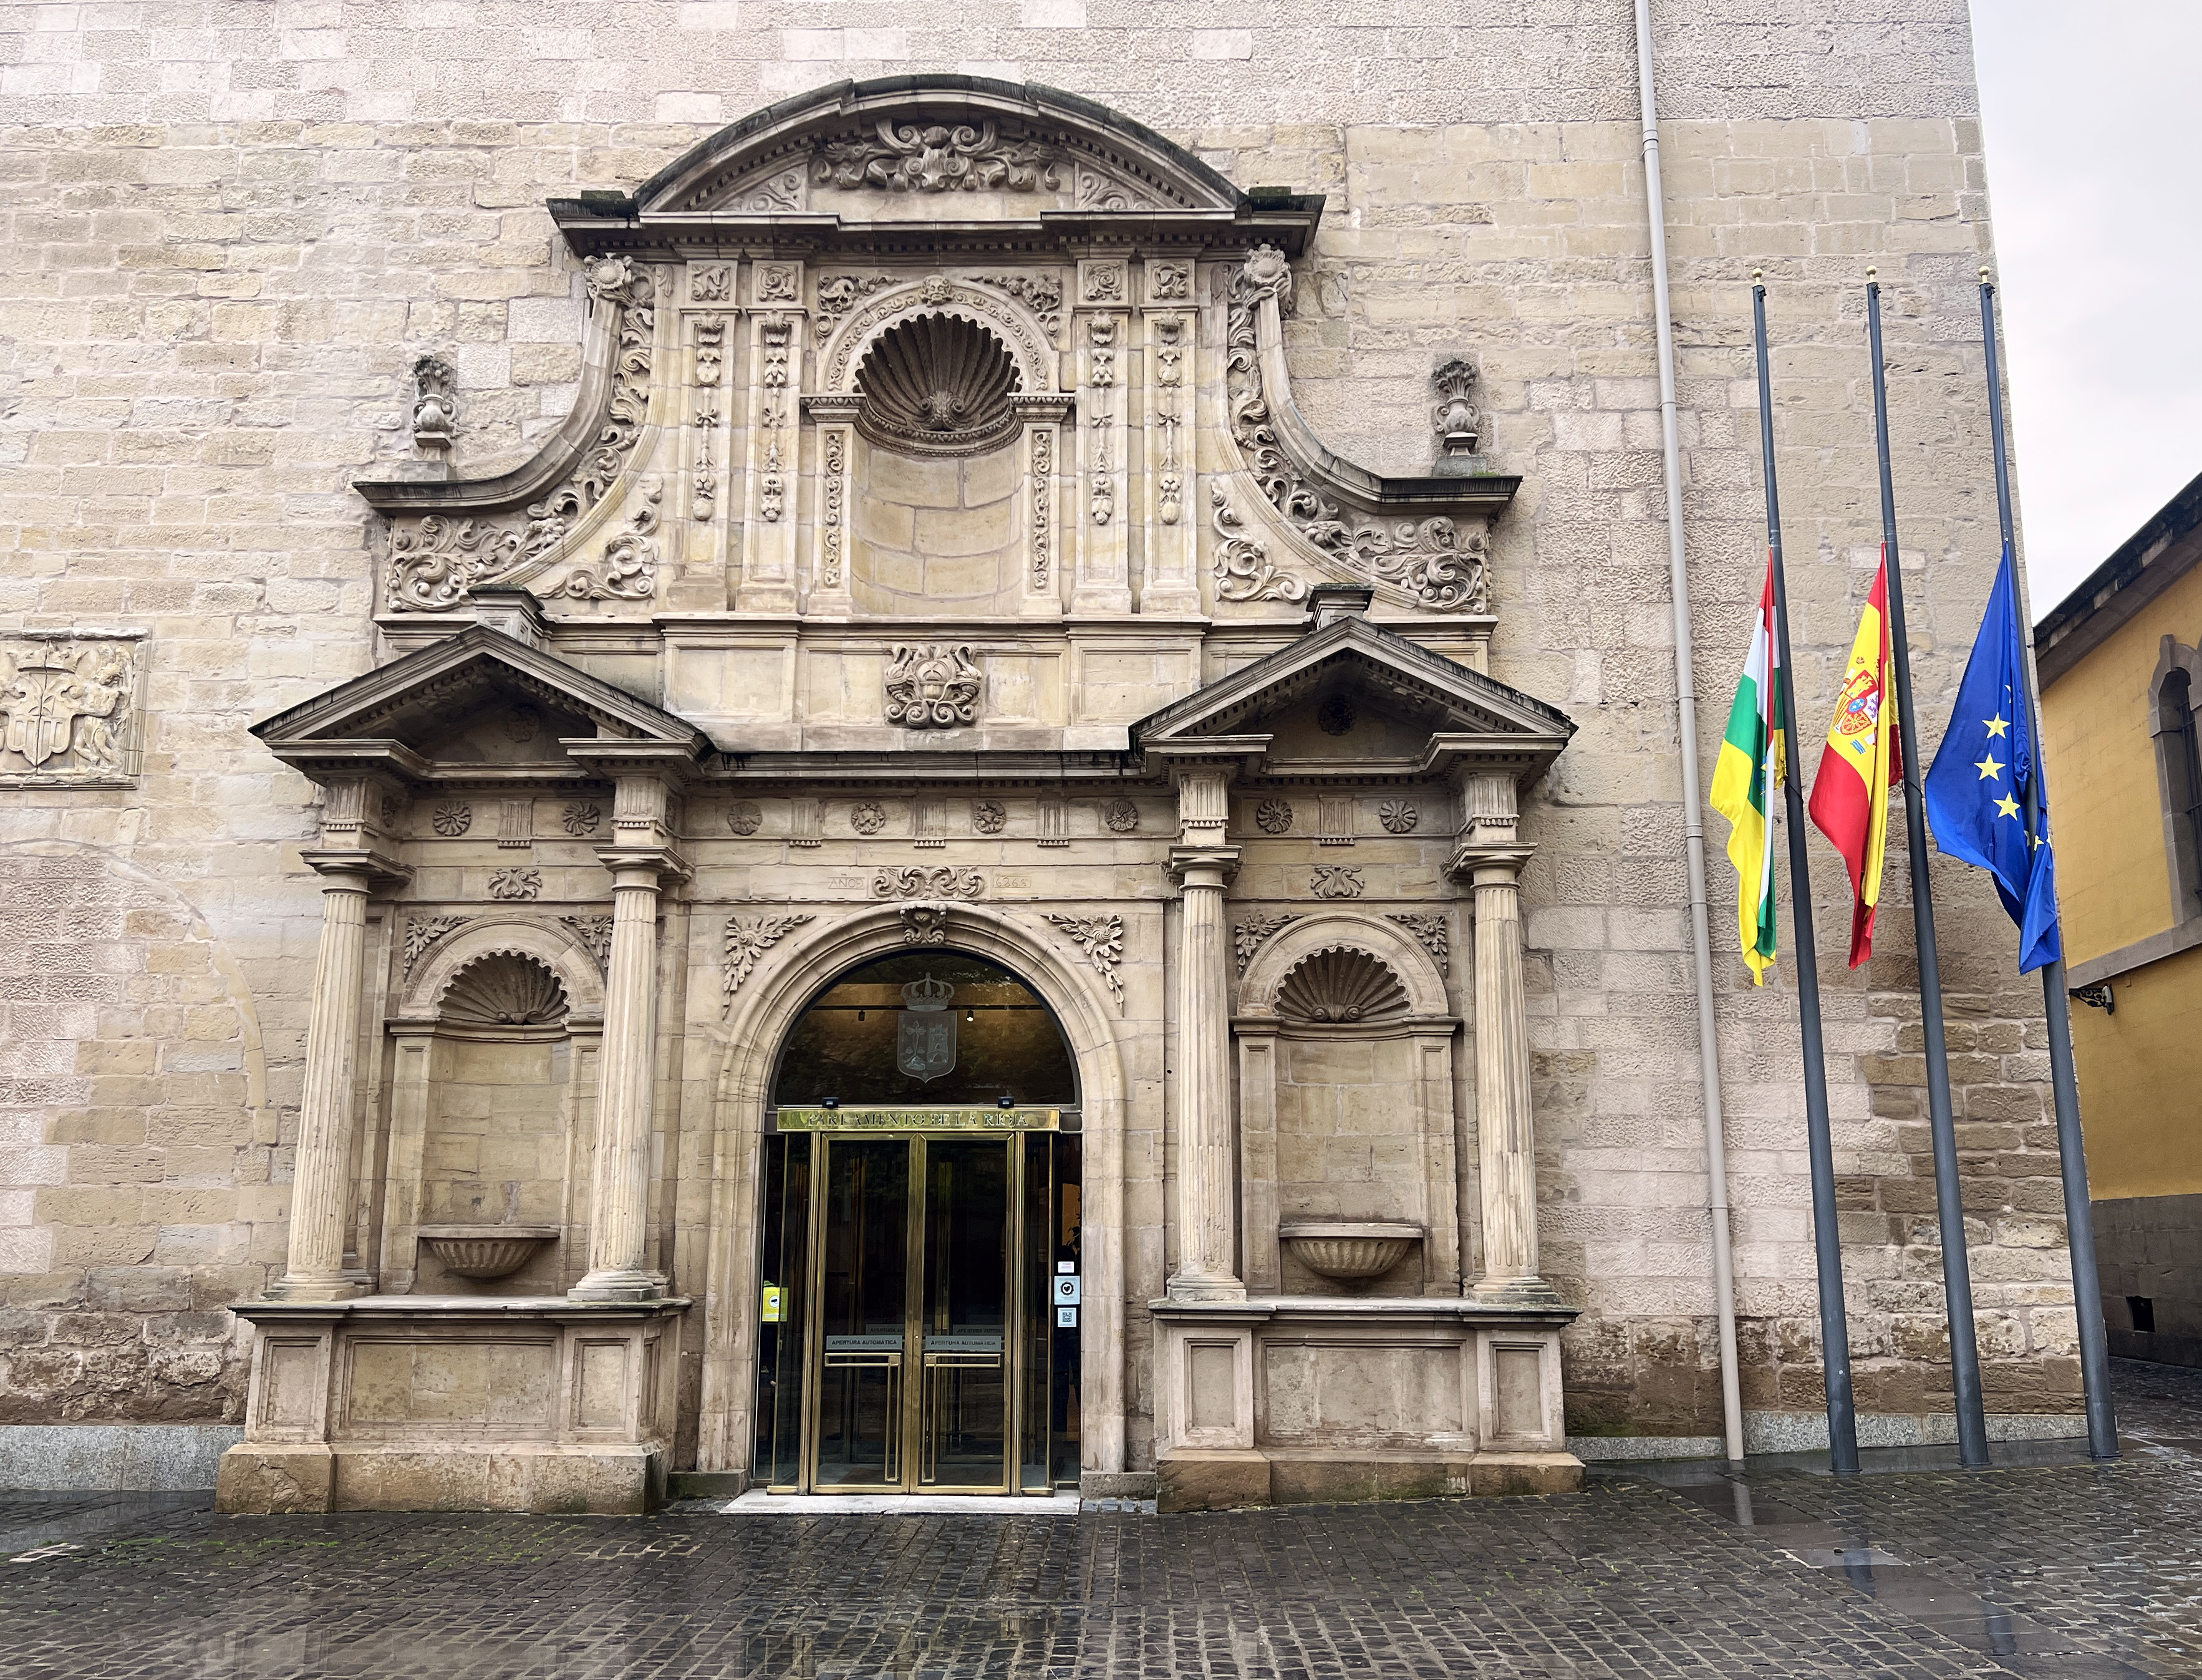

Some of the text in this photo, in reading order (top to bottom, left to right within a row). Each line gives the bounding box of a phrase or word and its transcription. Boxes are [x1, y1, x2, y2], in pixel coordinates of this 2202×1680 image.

[808, 1113, 1028, 1127] PARLAMENTO DE LA RIOJA
